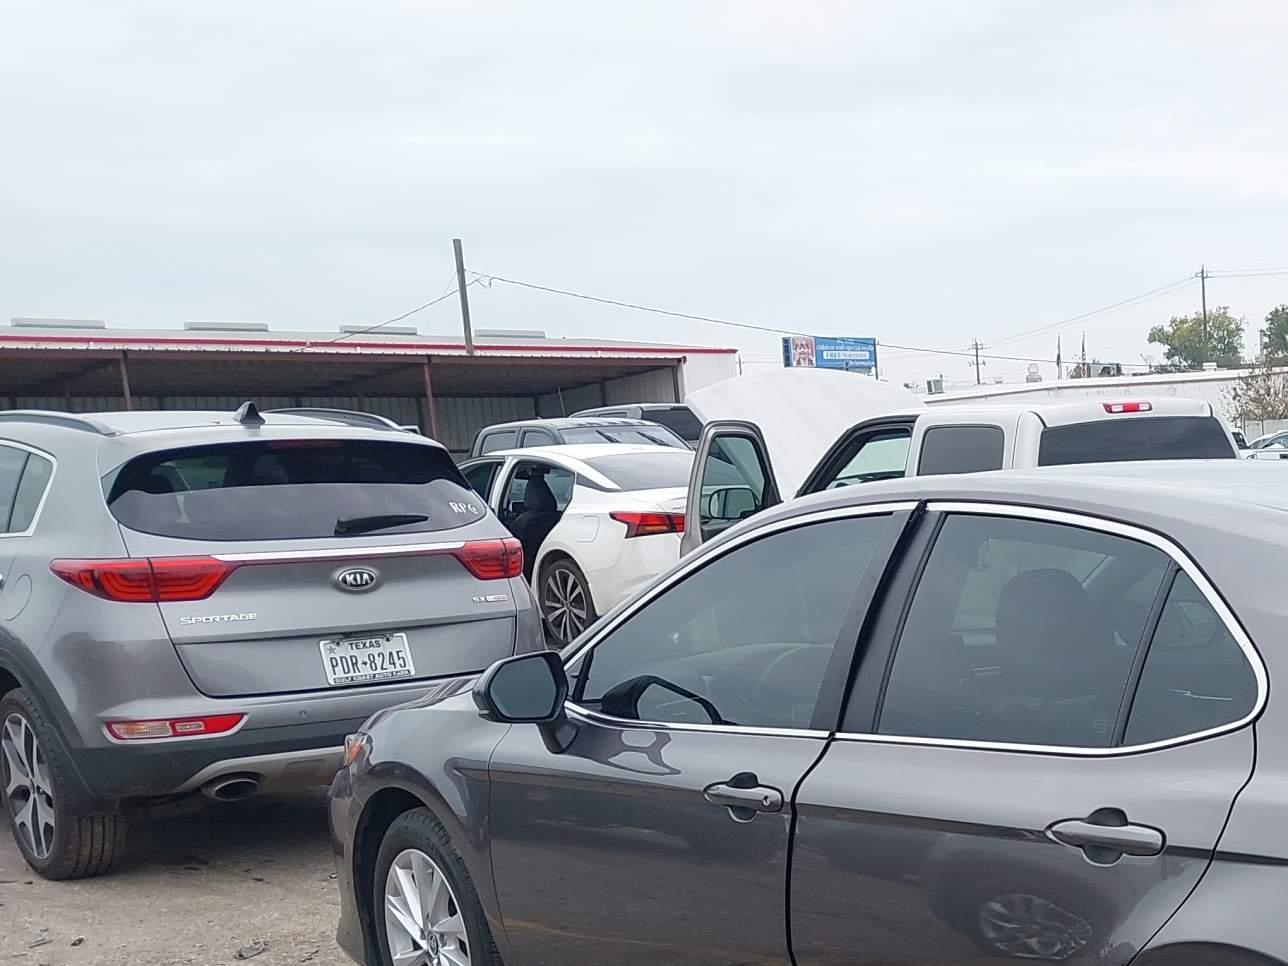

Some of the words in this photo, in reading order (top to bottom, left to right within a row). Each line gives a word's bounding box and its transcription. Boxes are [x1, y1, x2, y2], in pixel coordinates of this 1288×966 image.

[344, 572, 372, 586] KIA
[179, 612, 257, 625] SPORTAGE
[348, 640, 381, 650] TEXAS
[330, 655, 361, 675] PDR
[367, 650, 407, 672] 8245
